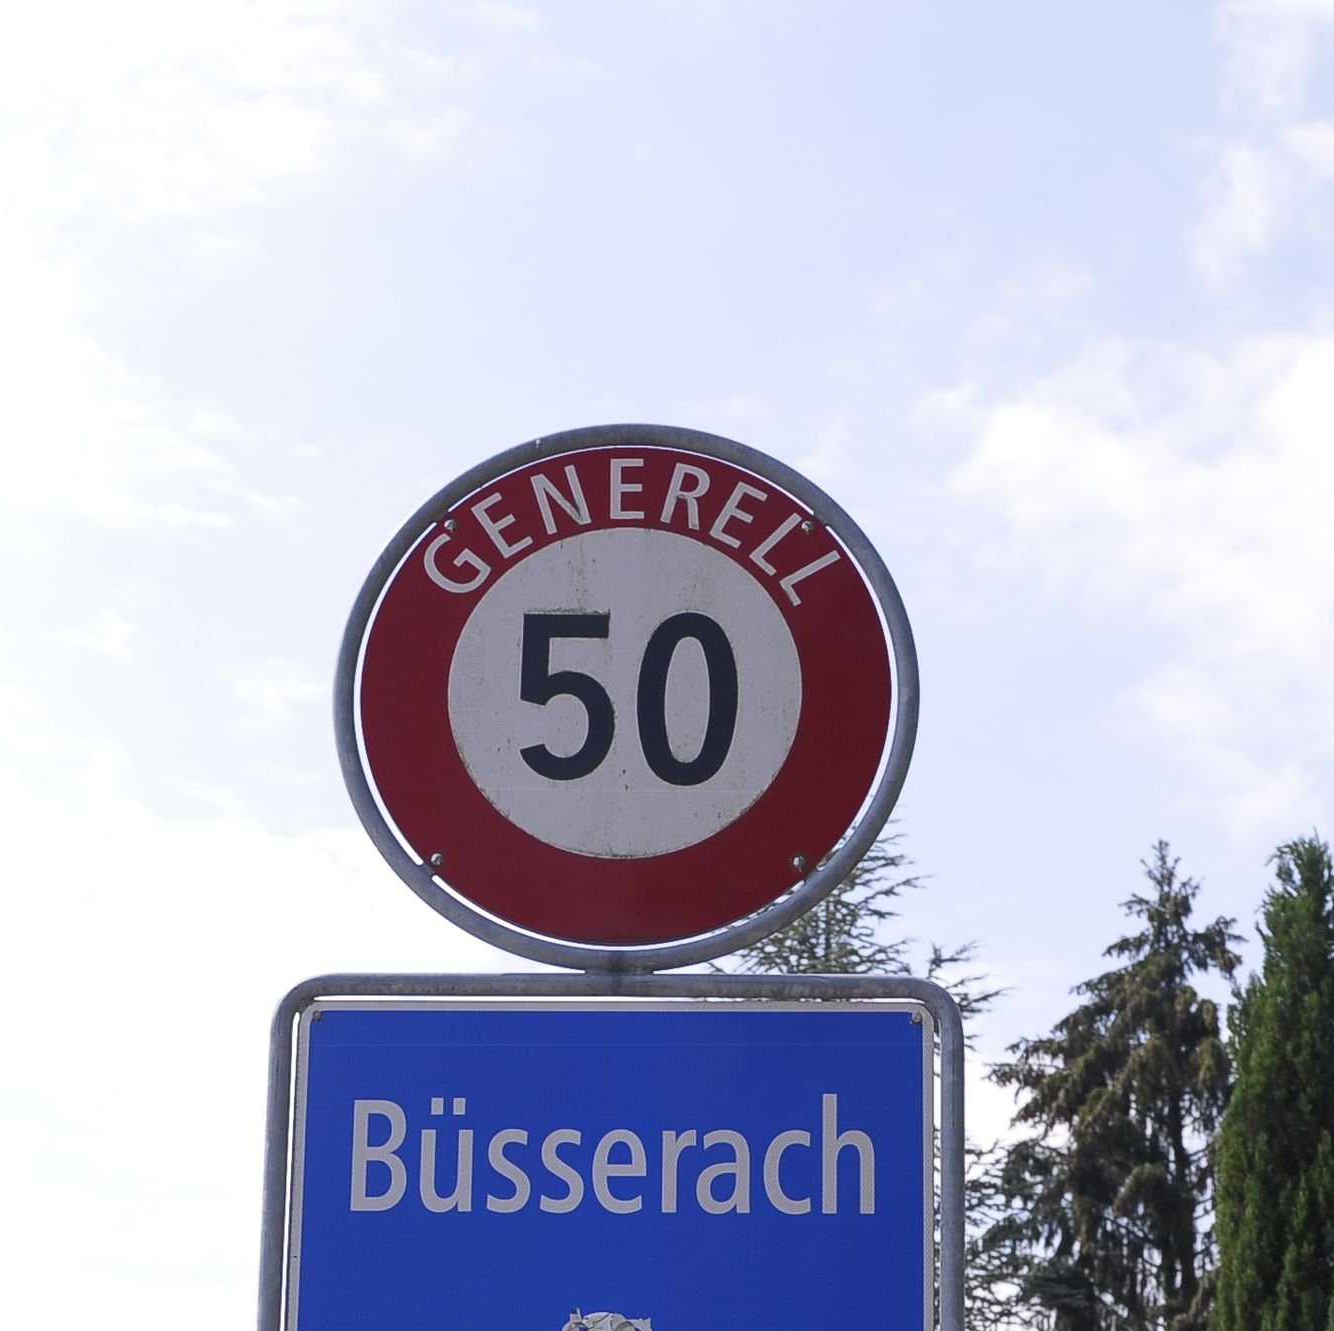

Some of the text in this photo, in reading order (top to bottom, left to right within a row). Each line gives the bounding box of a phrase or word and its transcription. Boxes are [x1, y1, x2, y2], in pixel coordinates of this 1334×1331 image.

[423, 457, 841, 606] GENERELL
[518, 611, 739, 786] 50
[349, 1093, 876, 1215] Büsserach
